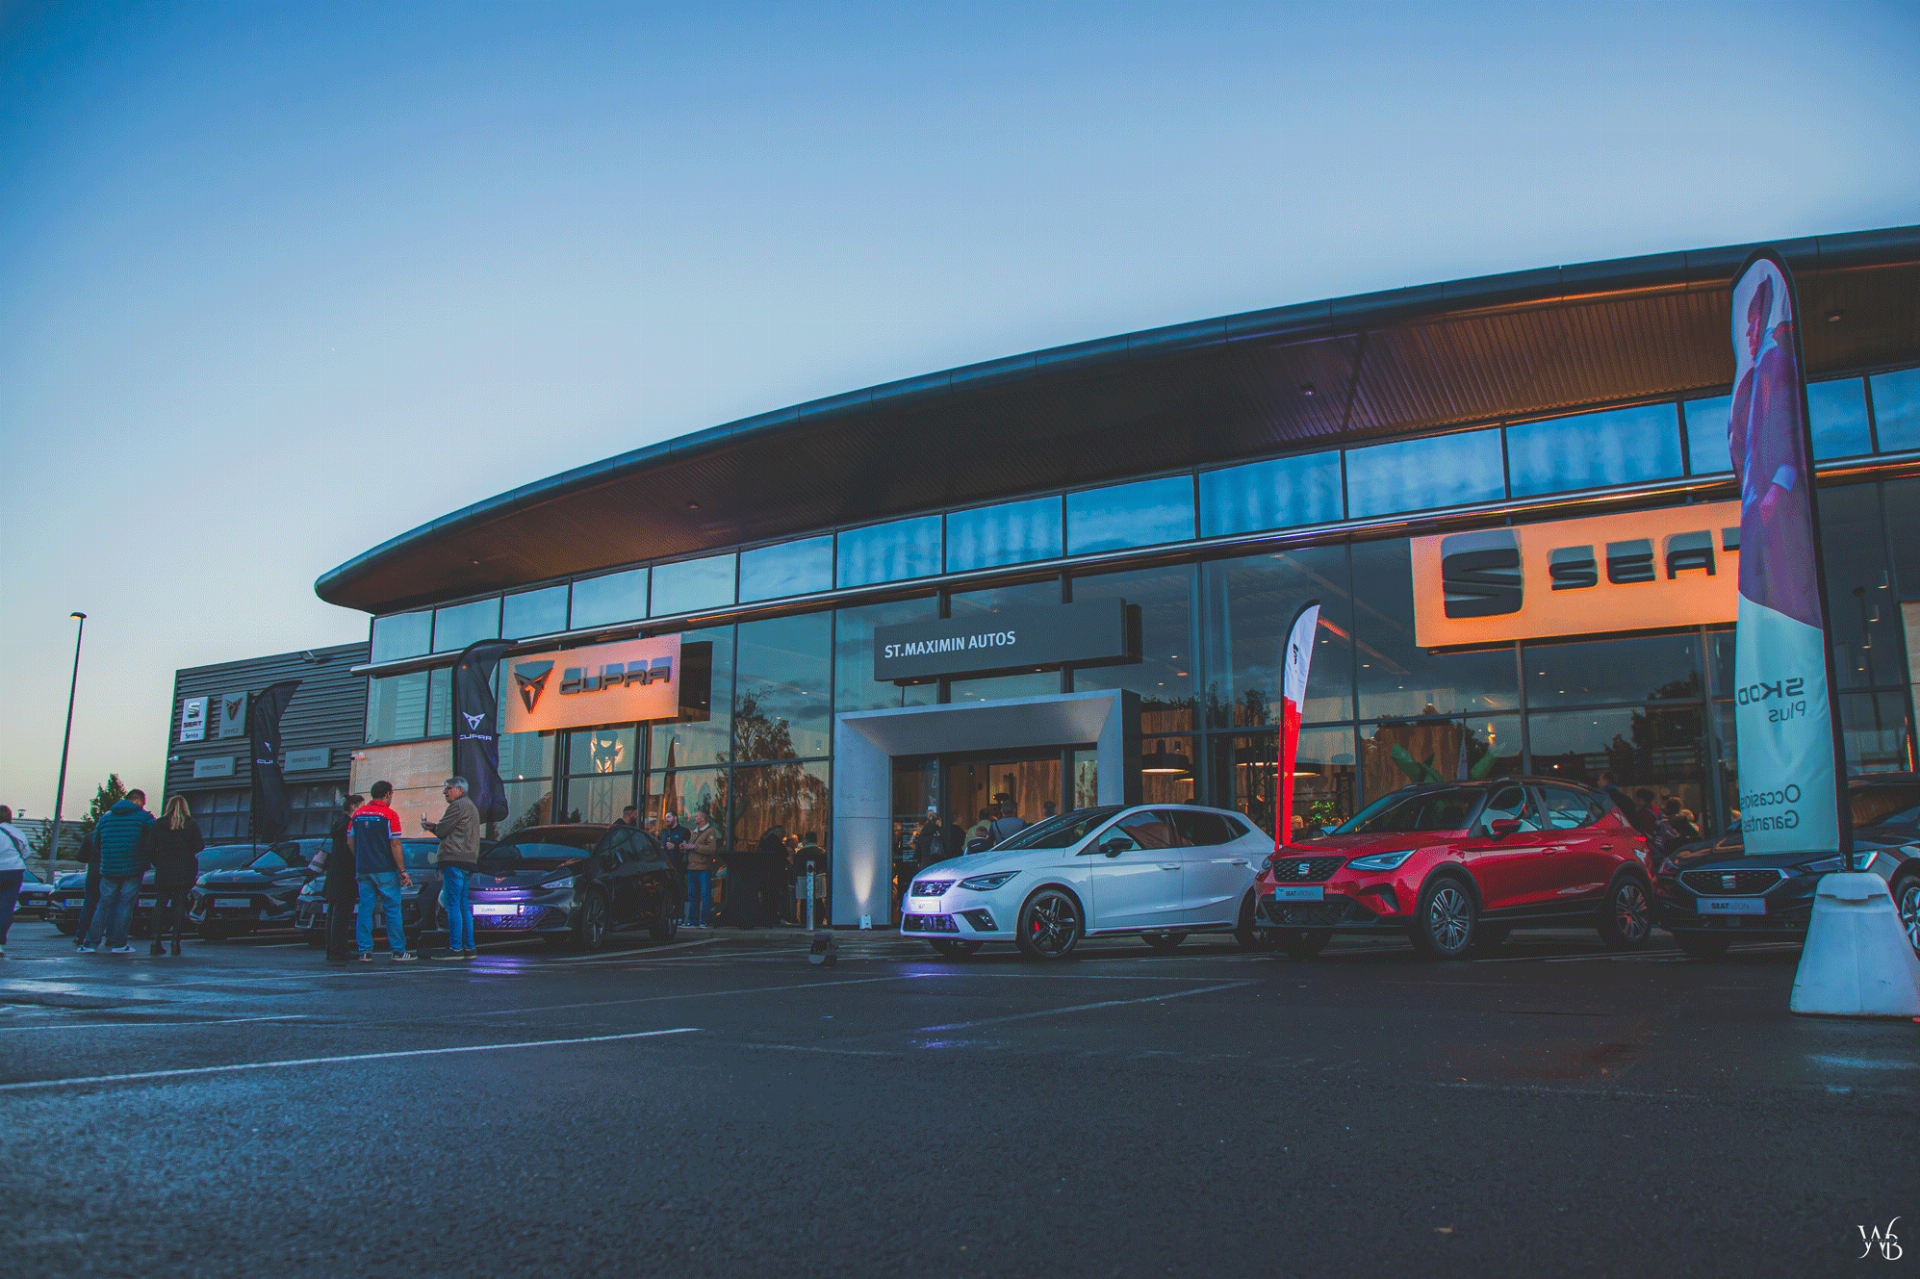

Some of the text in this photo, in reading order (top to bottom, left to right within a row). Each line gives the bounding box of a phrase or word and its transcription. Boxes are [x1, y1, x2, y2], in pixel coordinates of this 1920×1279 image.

[884, 630, 1016, 658] ST.MAXIMIN AUTOS
[559, 661, 671, 696] CUPRA
[1730, 902, 1749, 910] LEON
